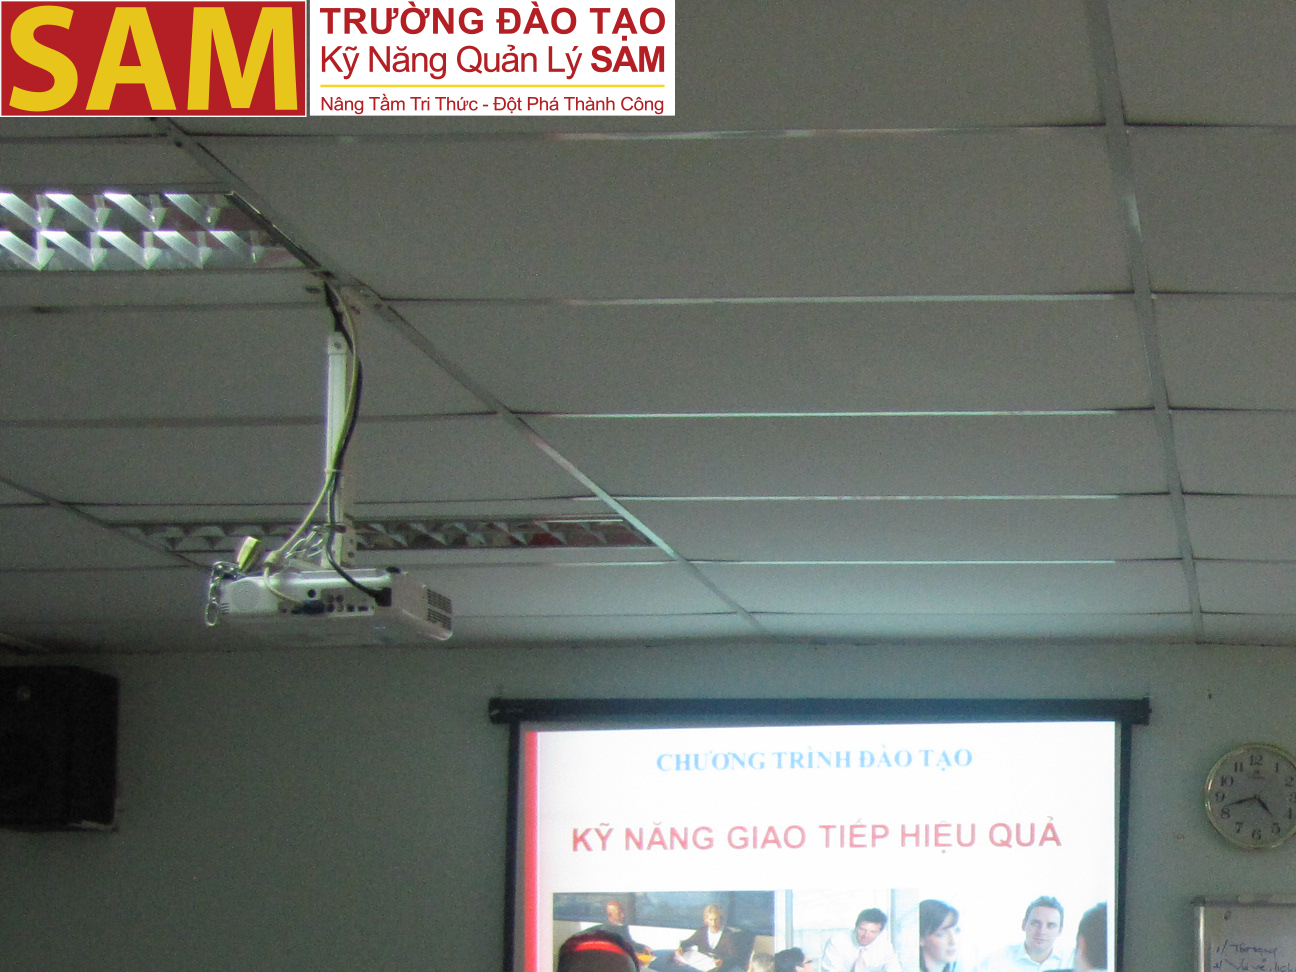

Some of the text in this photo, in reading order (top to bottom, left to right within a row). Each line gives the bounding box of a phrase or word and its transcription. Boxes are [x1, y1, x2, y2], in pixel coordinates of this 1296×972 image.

[656, 744, 973, 772] CHƯƠNG TRÌNH ĐÀO TẠO
[1250, 755, 1263, 766] 12
[1234, 762, 1243, 773] 11
[1220, 775, 1234, 787] 10
[1215, 791, 1225, 802] 9
[1220, 807, 1231, 820] 8
[1234, 822, 1244, 834] 7
[572, 816, 1062, 854] KỸ NĂNG GIAO TIẾP HIỆU QUẢ
[1252, 829, 1262, 840] 6
